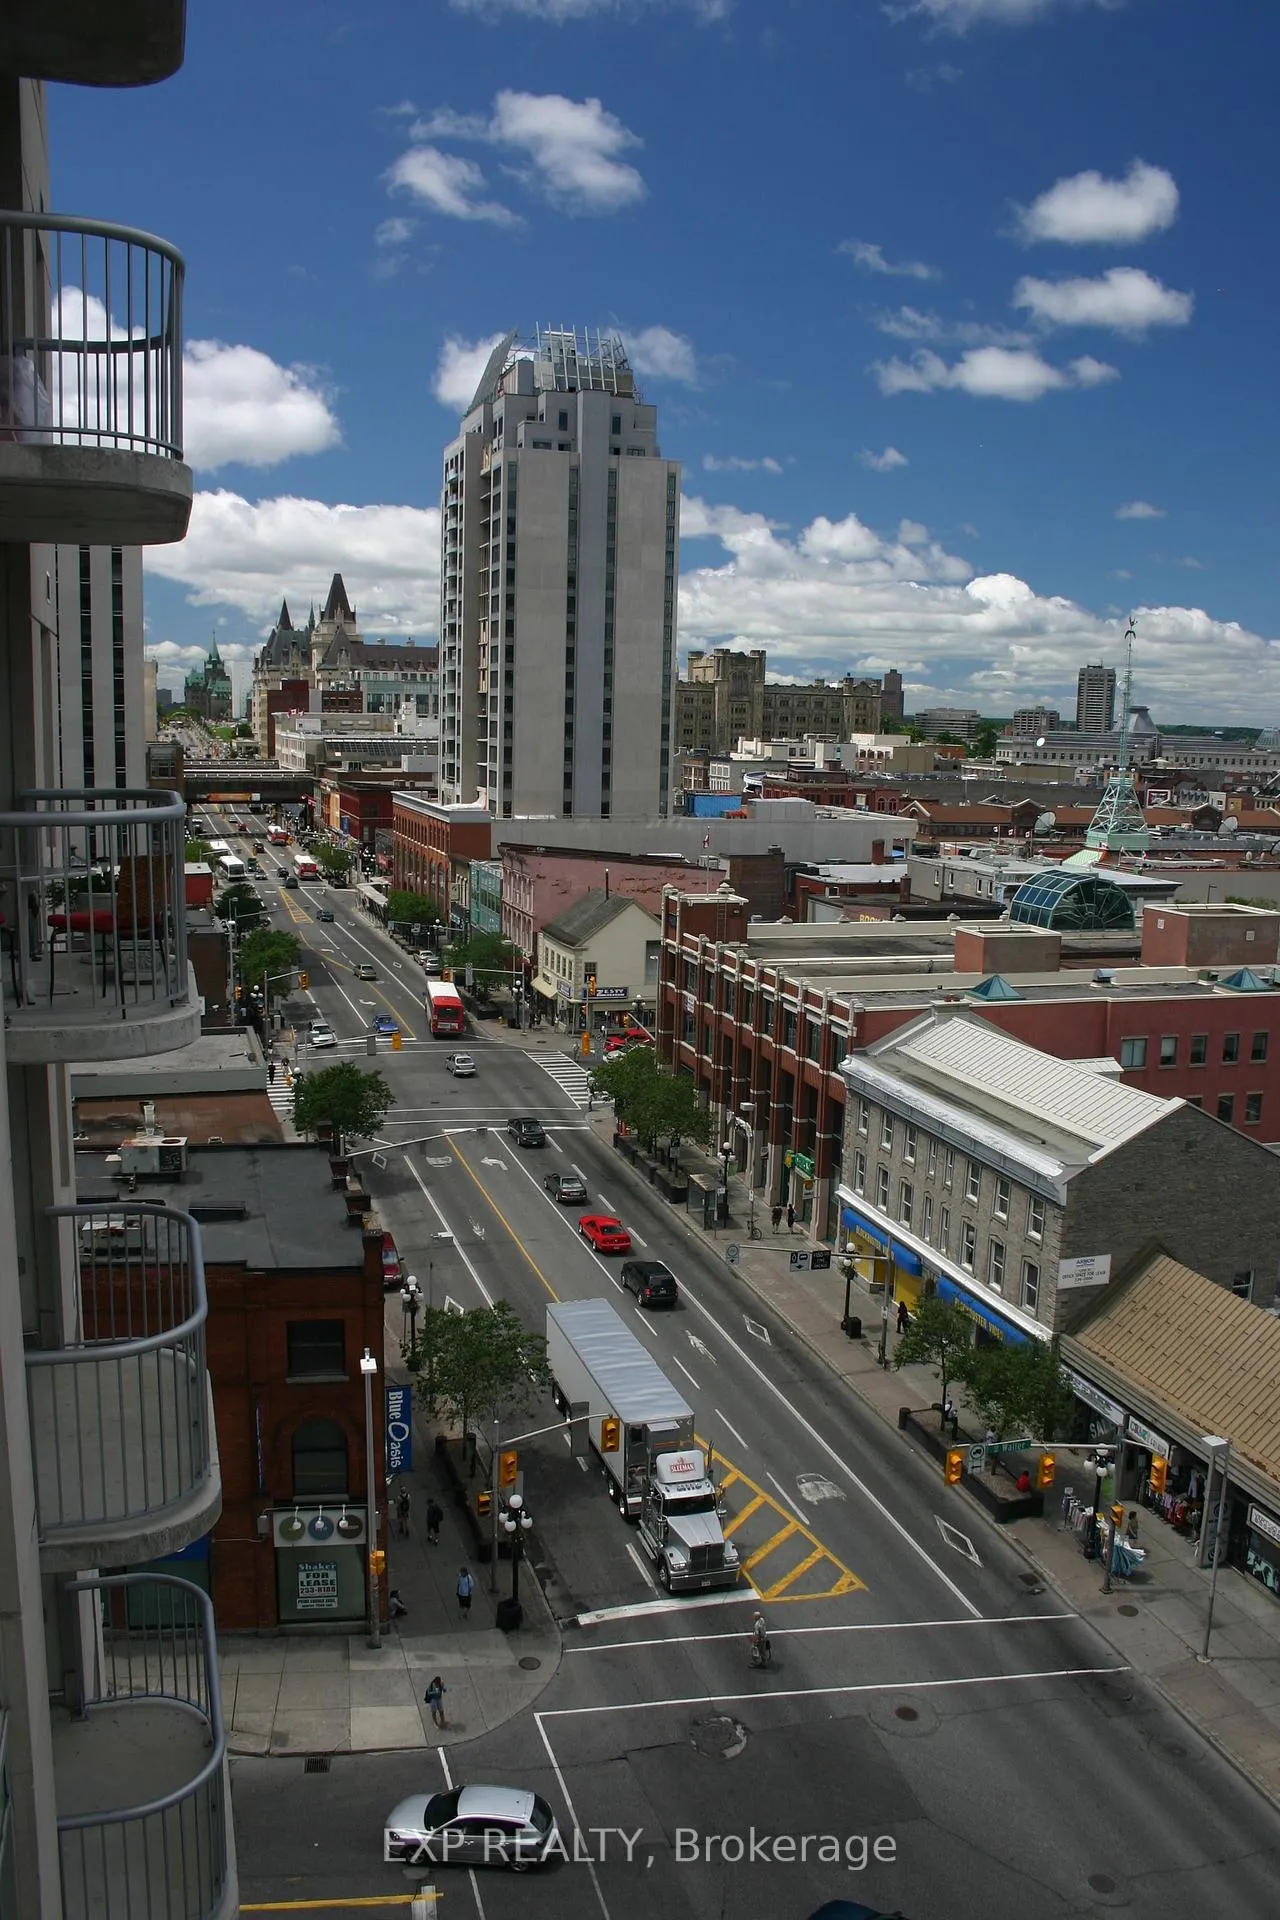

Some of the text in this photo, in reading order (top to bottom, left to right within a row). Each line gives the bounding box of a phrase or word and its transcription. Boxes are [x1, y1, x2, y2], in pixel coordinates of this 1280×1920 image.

[388, 1391, 410, 1468] Blue Oasis
[298, 1562, 337, 1571] Shaker
[300, 1579, 336, 1587] LEASE
